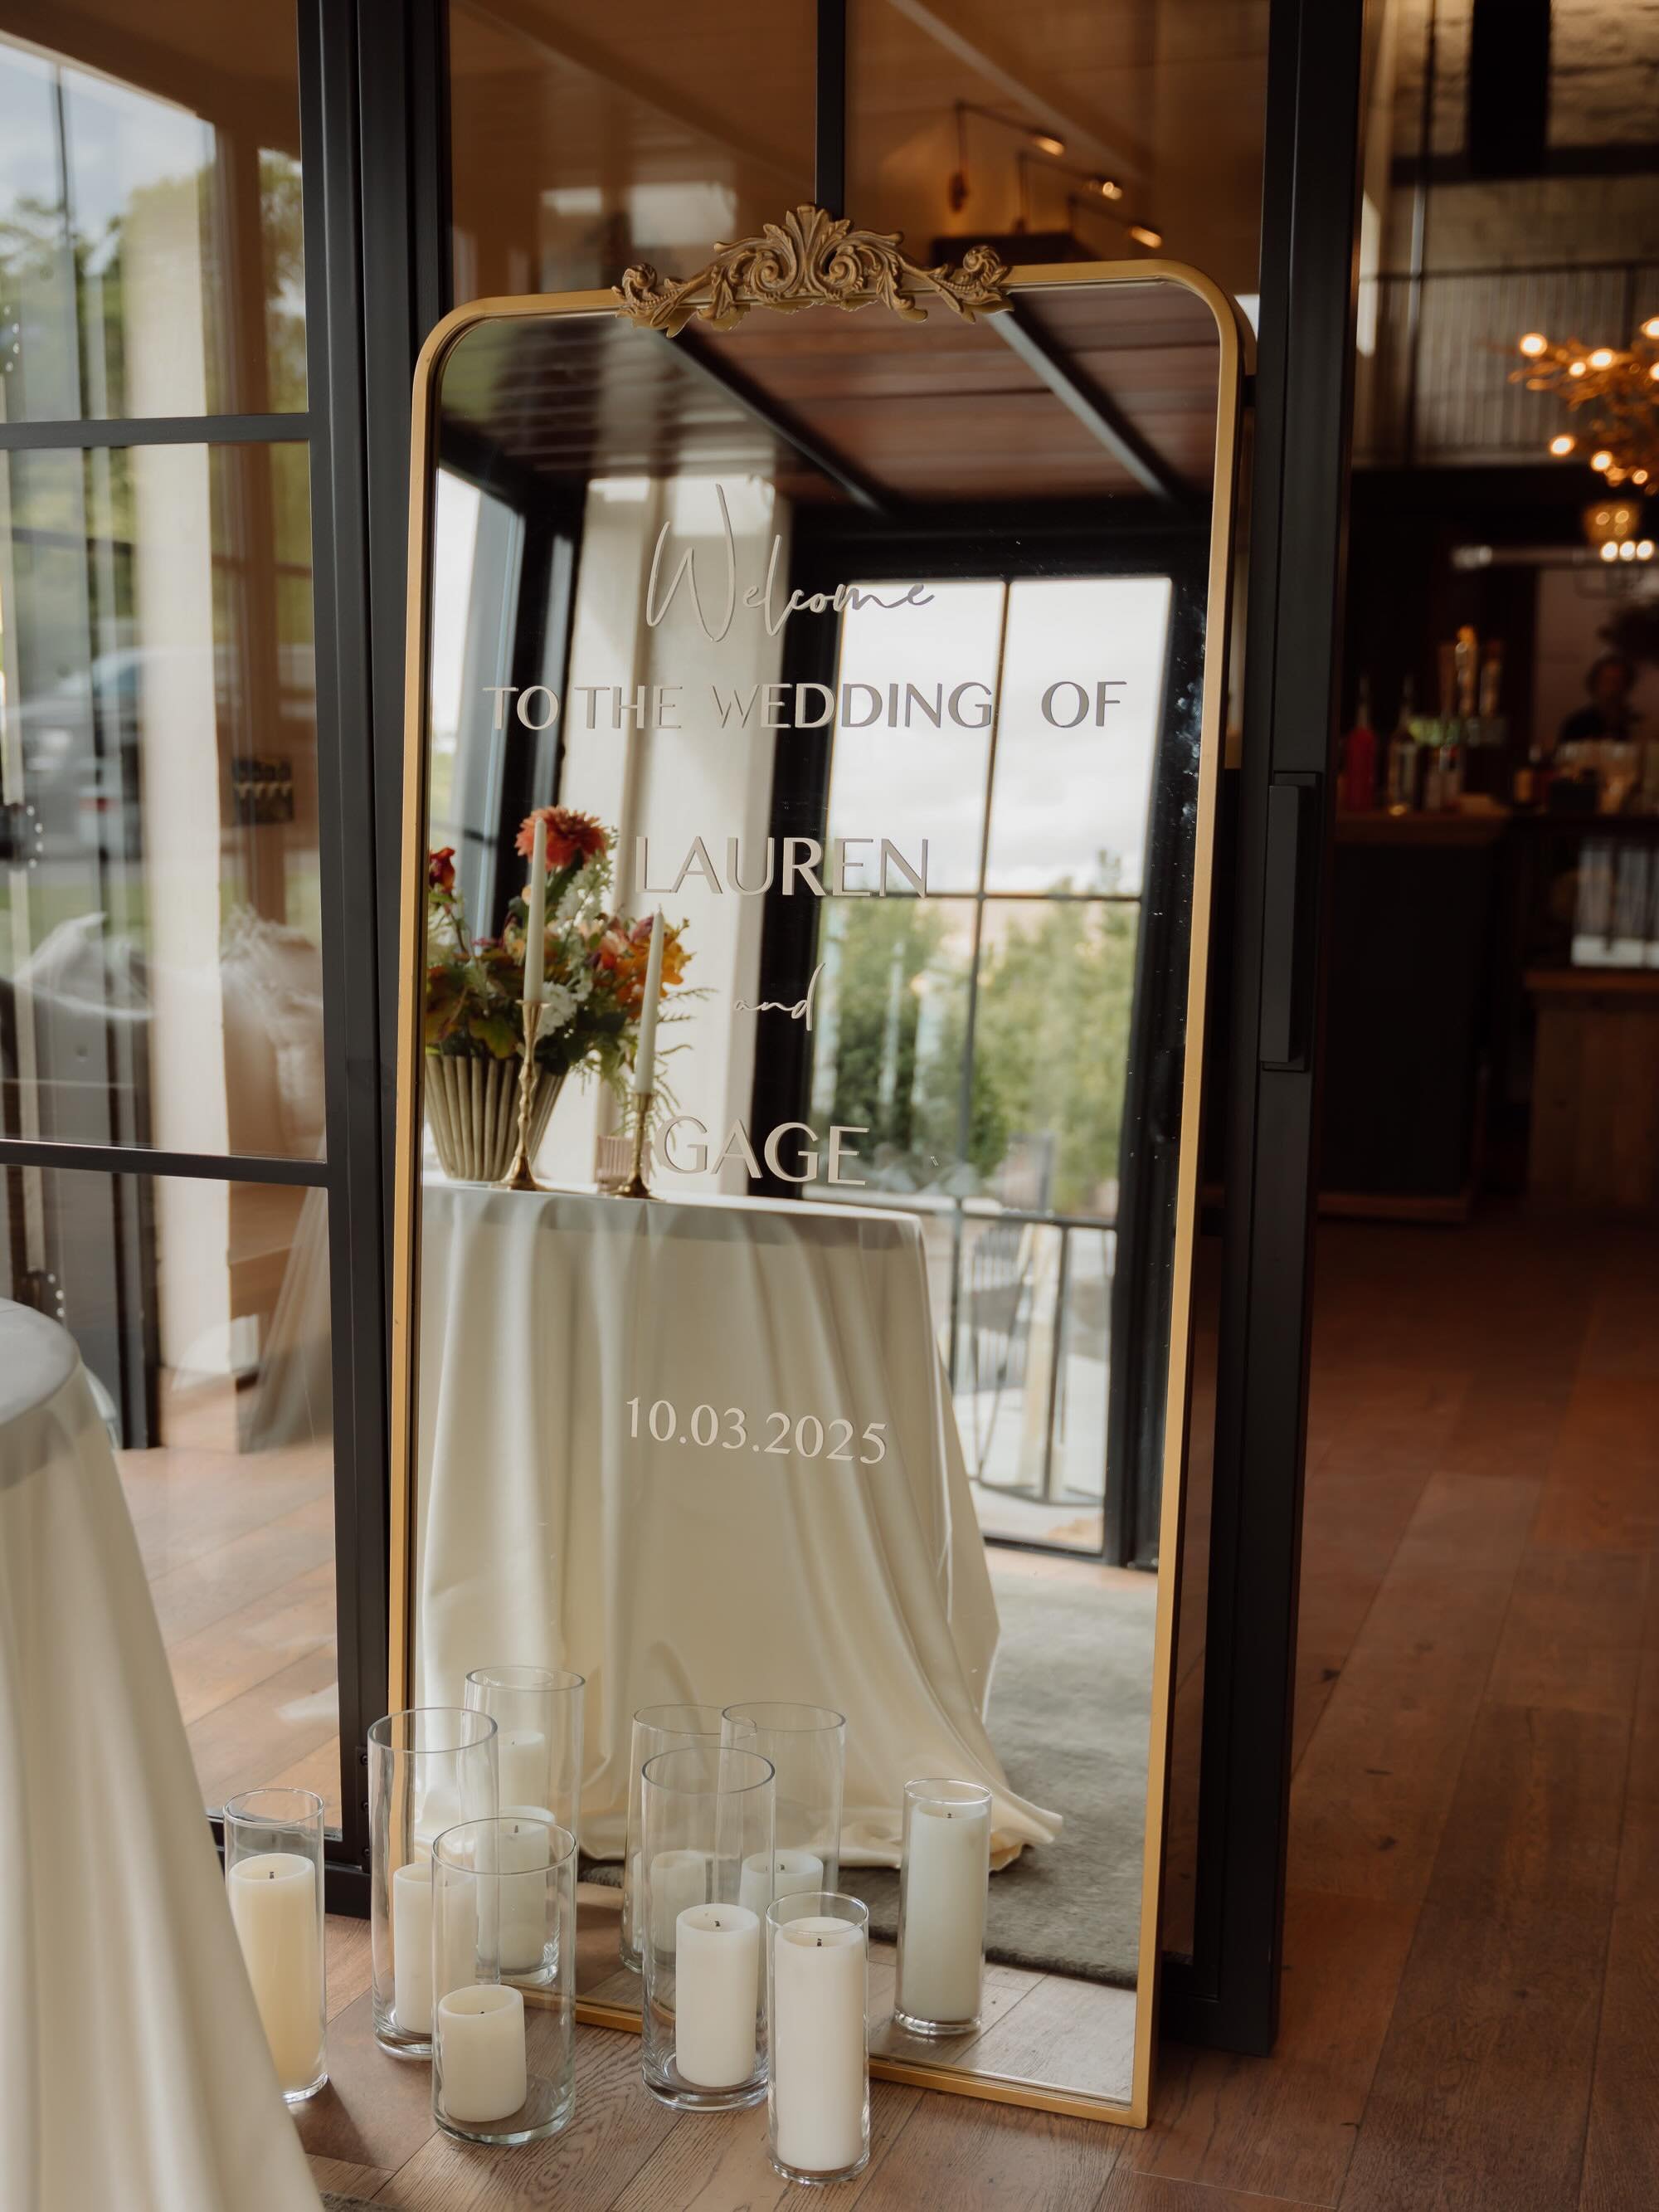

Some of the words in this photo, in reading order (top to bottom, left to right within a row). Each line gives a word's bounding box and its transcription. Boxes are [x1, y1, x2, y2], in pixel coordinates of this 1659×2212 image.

[646, 484, 935, 642] Welcome
[483, 684, 560, 731] TO
[574, 685, 683, 729] THE
[712, 681, 993, 730] WEDDING
[1041, 680, 1127, 728] OF
[635, 836, 928, 899] LAUREN
[734, 962, 825, 1031] and
[654, 1115, 870, 1186] GAGE
[626, 1397, 886, 1464] 10.03.2025
